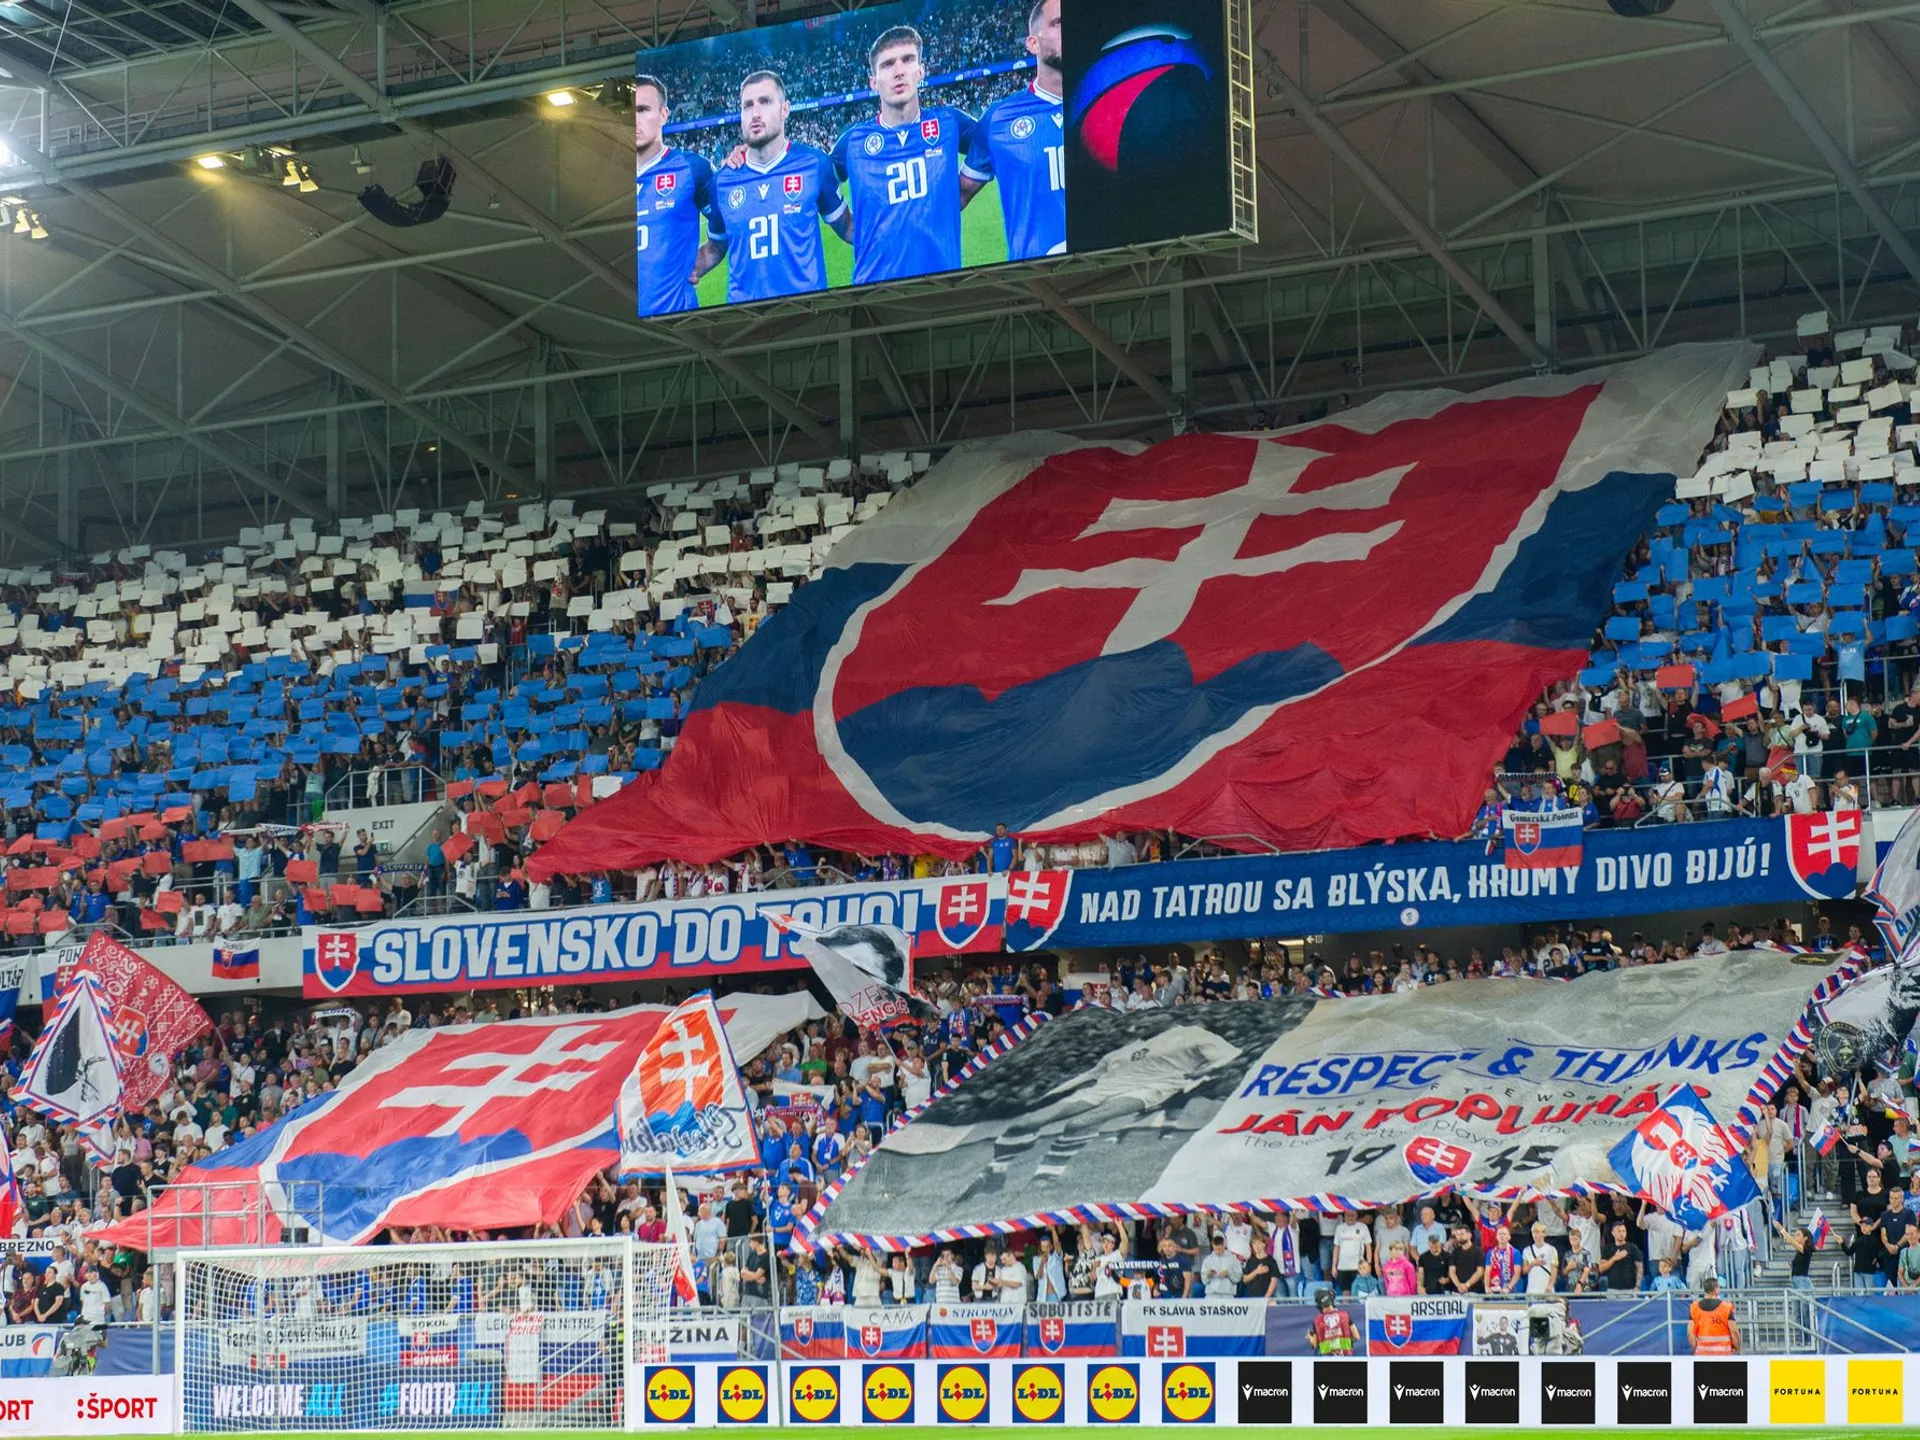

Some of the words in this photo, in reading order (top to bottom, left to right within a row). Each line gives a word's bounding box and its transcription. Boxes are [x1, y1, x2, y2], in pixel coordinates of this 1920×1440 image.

[886, 158, 928, 205] 20
[750, 214, 779, 260] 21
[372, 820, 395, 830] EXIT
[1080, 890, 1140, 924] NAD
[1152, 881, 1262, 918] TATROU
[1274, 878, 1313, 910] SA
[1328, 863, 1461, 907] BLÝSKA,
[1596, 852, 1672, 892] DIVO
[1687, 837, 1771, 883] BIJÚ!
[373, 914, 659, 984] SLOVENSKO
[672, 907, 742, 966] DO
[1487, 1046, 1534, 1078] &
[1550, 1032, 1768, 1084] THANKS
[1216, 1108, 1355, 1137] JÁN
[1325, 1143, 1397, 1177] 19
[1143, 1306, 1156, 1316] FK
[1200, 1303, 1249, 1316] STAŠKOV
[1411, 1299, 1466, 1317] ARSENAL
[411, 1319, 449, 1330] SOKOL
[1711, 1316, 1722, 1325] 36
[1253, 1387, 1288, 1397] macron
[1329, 1387, 1364, 1397] macron
[1405, 1387, 1440, 1397] macron
[1481, 1387, 1516, 1397] macron
[1557, 1387, 1592, 1397] macron
[1633, 1387, 1668, 1397] macron
[1709, 1387, 1744, 1397] macron
